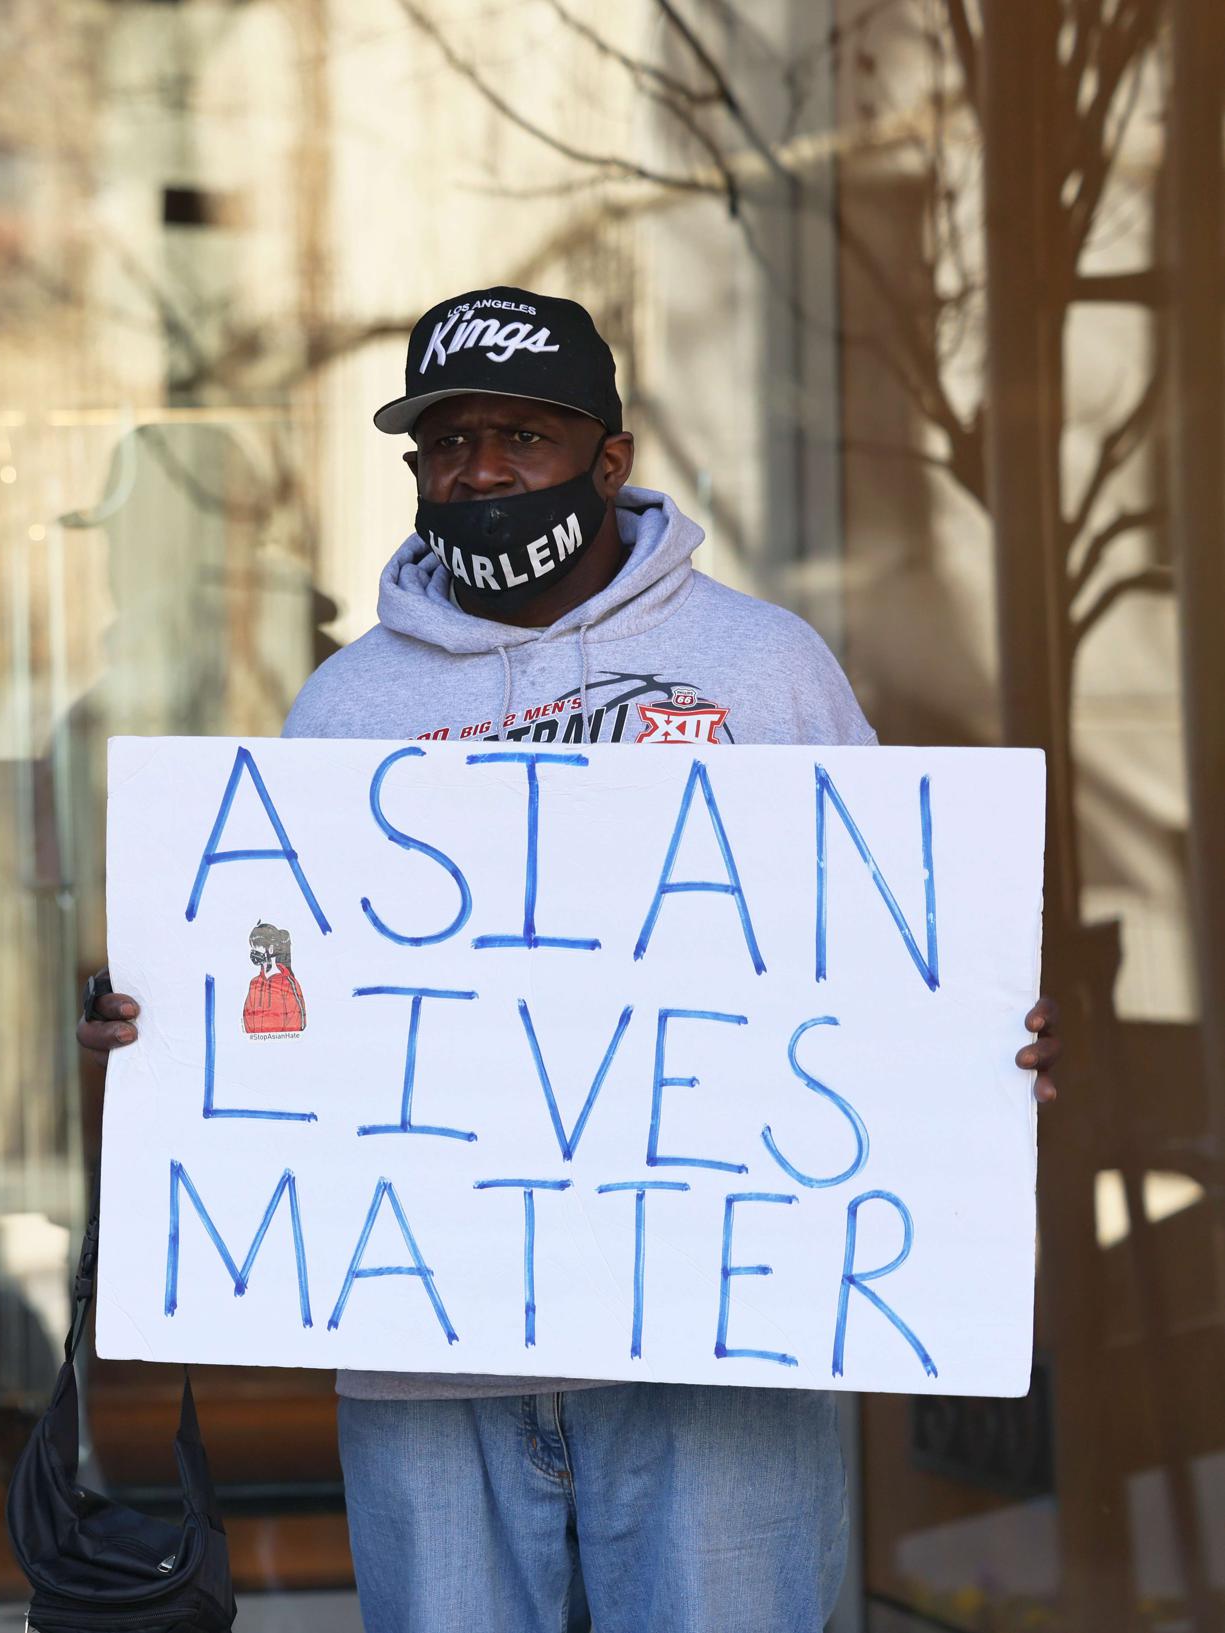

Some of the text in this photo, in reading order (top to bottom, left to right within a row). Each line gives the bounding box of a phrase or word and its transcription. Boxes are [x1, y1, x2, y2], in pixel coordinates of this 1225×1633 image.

[419, 311, 560, 375] Kings
[447, 299, 537, 318] LOS ANGELES
[428, 512, 584, 591] HARLEM
[459, 720, 492, 739] BIG
[523, 697, 582, 722] MEN'S
[677, 696, 692, 704] 66
[185, 746, 941, 993] ASIAN
[203, 974, 872, 1190] LIVES
[164, 1159, 939, 1378] MATTER
